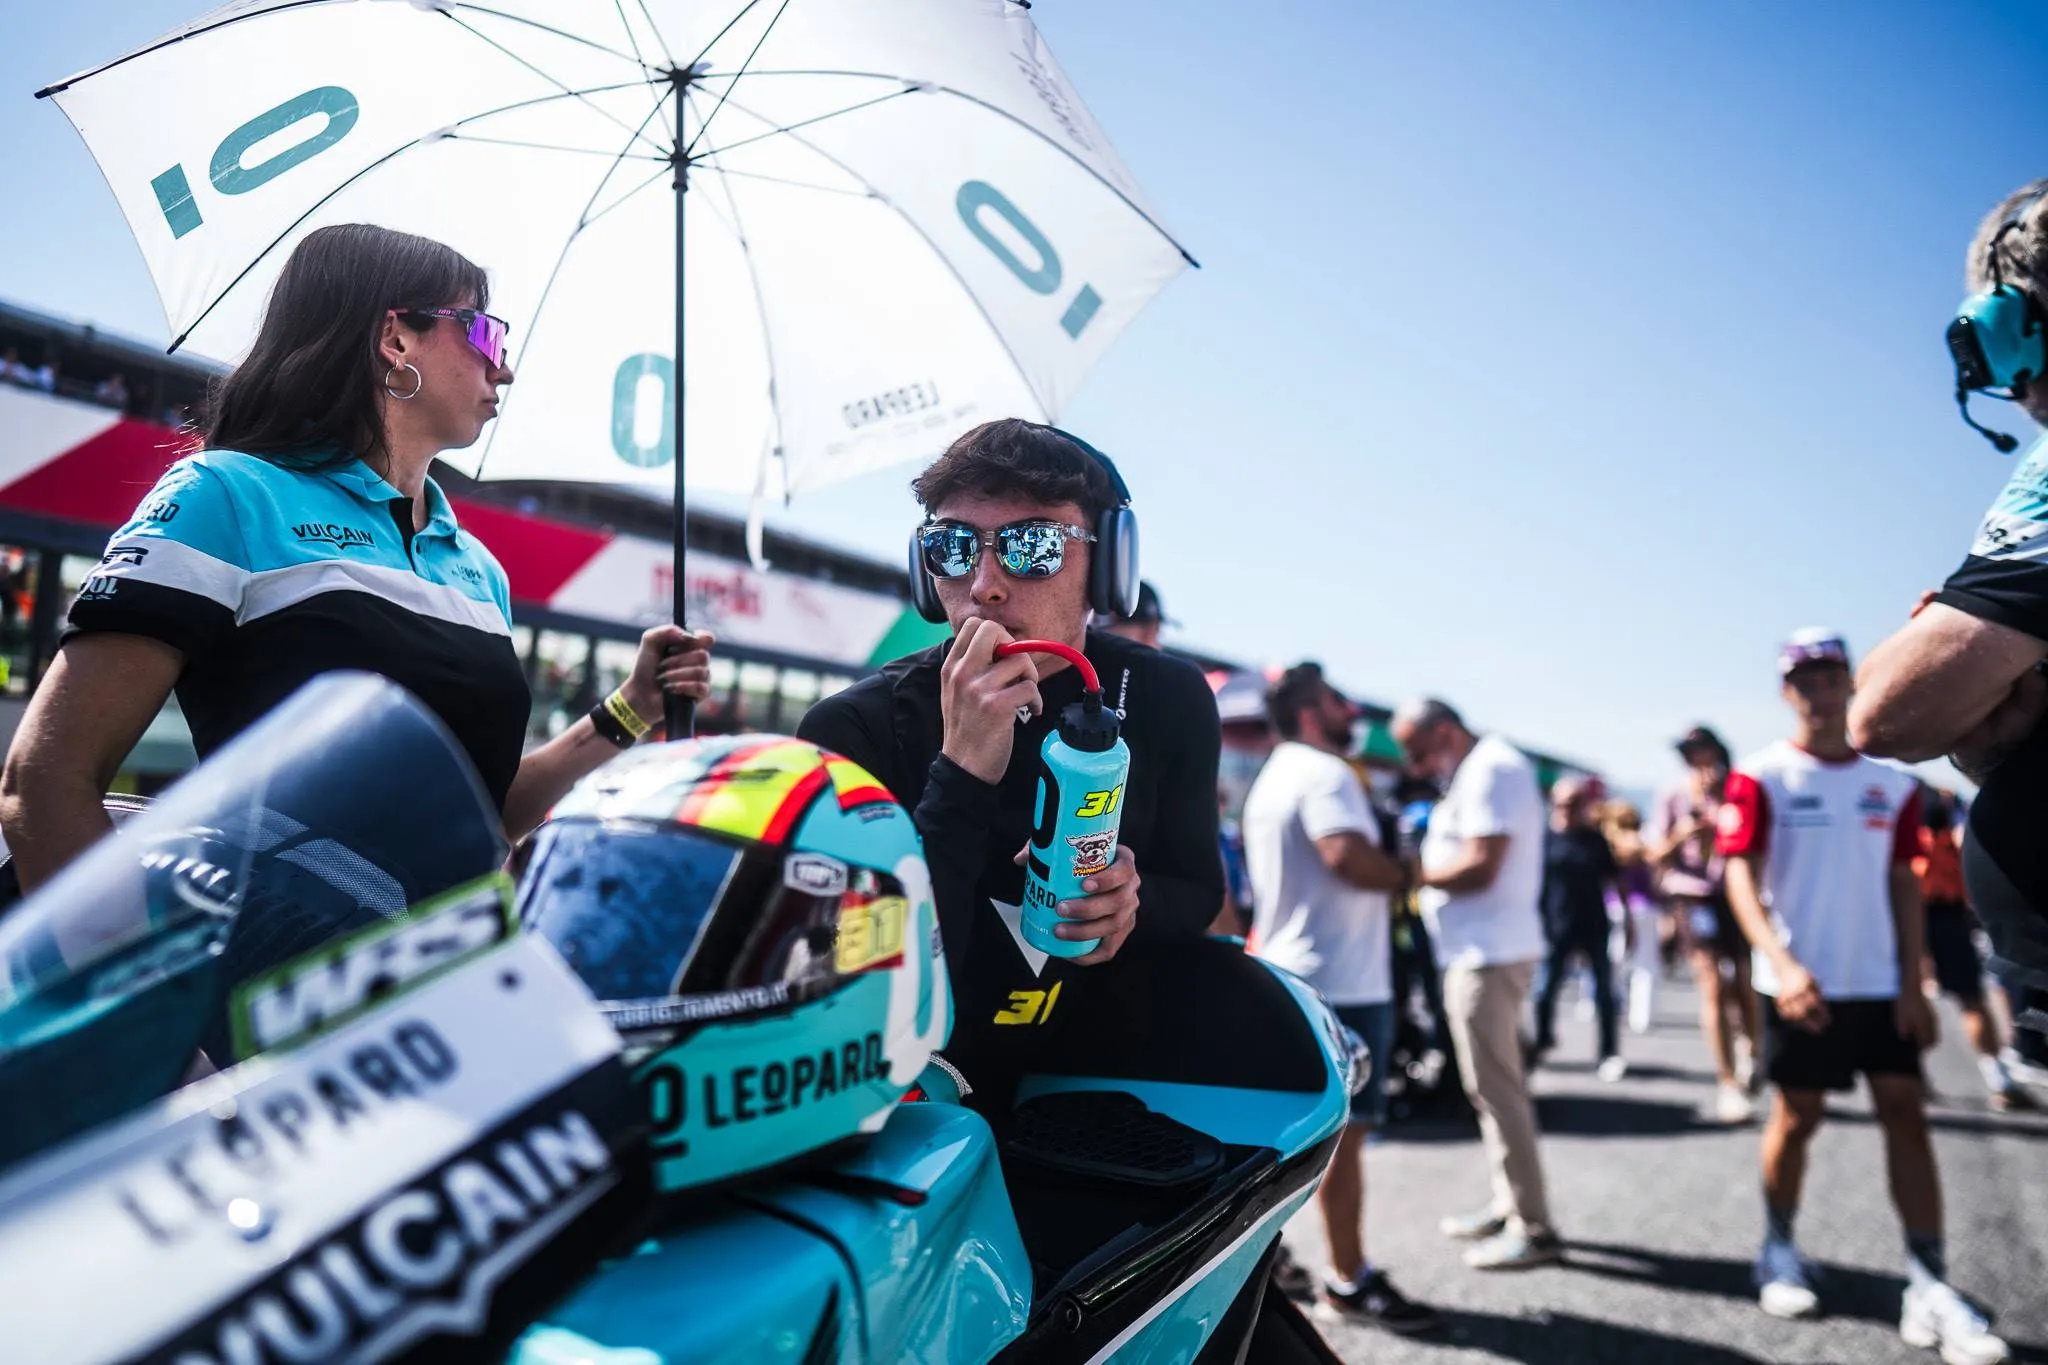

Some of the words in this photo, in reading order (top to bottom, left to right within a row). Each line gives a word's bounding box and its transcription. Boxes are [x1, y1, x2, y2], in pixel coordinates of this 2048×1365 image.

[291, 522, 375, 546] VULCAIN
[1075, 783, 1124, 818] 31
[1025, 874, 1057, 909] PARD
[993, 980, 1064, 1026] 31
[706, 1034, 884, 1128] LEOPARD
